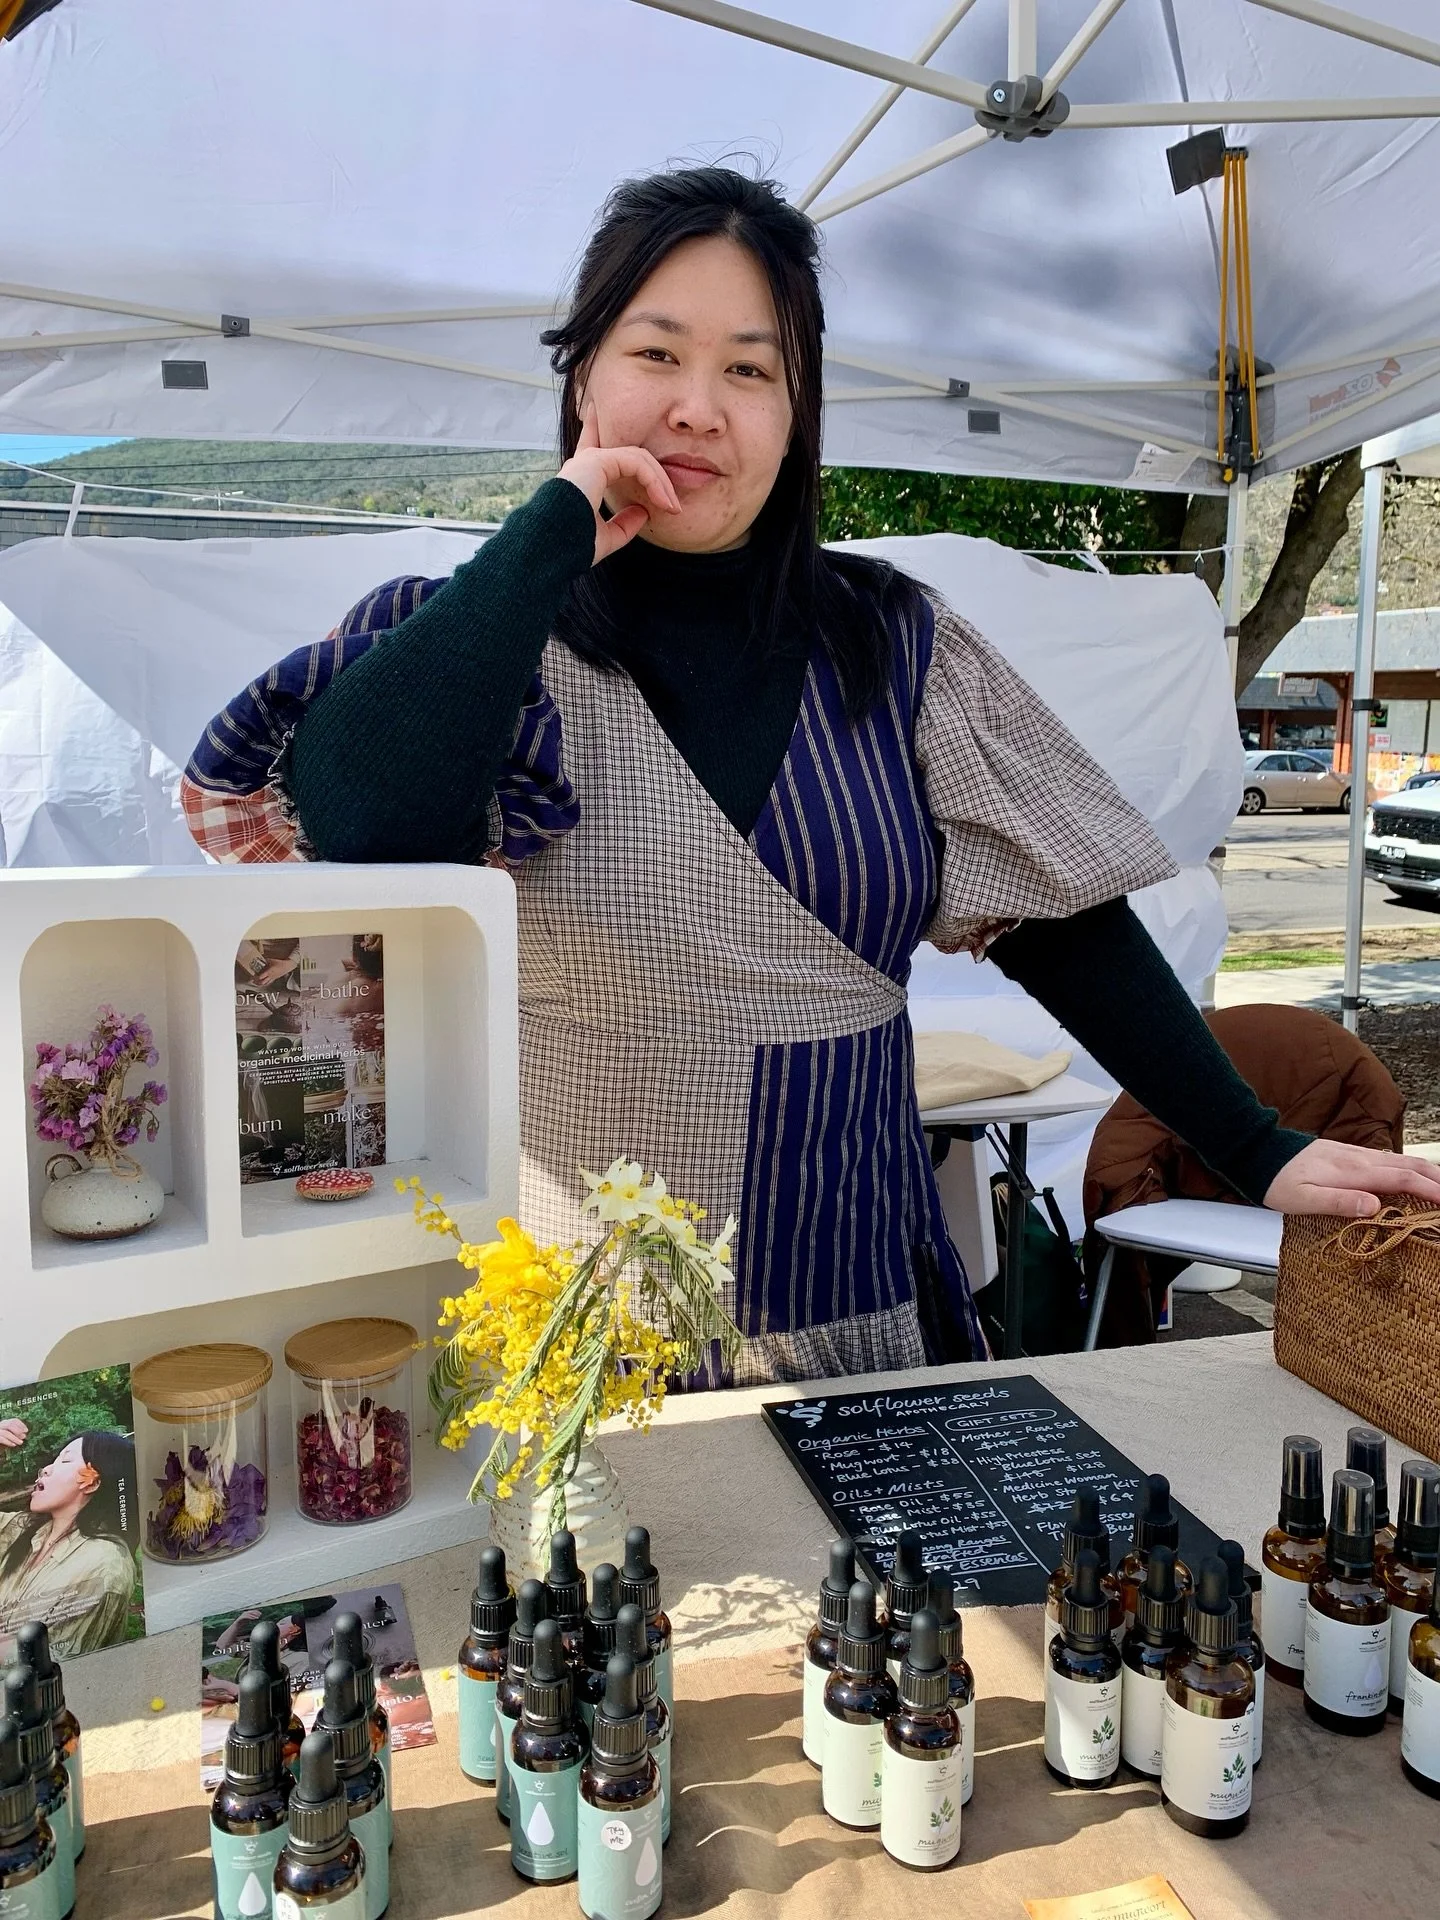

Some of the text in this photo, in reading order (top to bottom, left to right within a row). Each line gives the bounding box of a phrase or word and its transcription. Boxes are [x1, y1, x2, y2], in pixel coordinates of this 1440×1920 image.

[320, 981, 370, 999] bathe
[239, 1048, 366, 1069] organic medicinal herbs
[323, 1105, 372, 1125] make
[239, 1118, 283, 1135] burn
[283, 1160, 339, 1173] solflower seeds
[16, 1391, 58, 1407] ESSENCES
[837, 1386, 1011, 1417] solflower seeds
[956, 1411, 1038, 1428] GIFT SETS
[797, 1426, 926, 1451] Organic Herbs
[961, 1429, 1012, 1443] Mother
[1053, 1419, 1079, 1429] Set
[1035, 1432, 1066, 1443] $90
[822, 1441, 914, 1460] Rose $14
[919, 1446, 950, 1459] $18
[1075, 1450, 1102, 1460] Set
[836, 1457, 961, 1483] Blue Lotus $38
[1065, 1461, 1107, 1473] $128
[832, 1488, 873, 1502] Oils
[887, 1480, 945, 1495] Mists
[1002, 1473, 1119, 1494] Medicine Woman
[1011, 1491, 1049, 1504] Herb
[1112, 1479, 1140, 1490] Kit
[859, 1491, 975, 1514] Rose Oil $55
[118, 1495, 128, 1532] CEREMONY
[865, 1512, 902, 1524] Rose
[906, 1504, 942, 1517] Mist
[869, 1525, 902, 1536] Blue
[902, 1519, 938, 1531] Lotus
[940, 1515, 962, 1525] Oil
[875, 1536, 898, 1547] Blu
[919, 1529, 950, 1541] otus
[950, 1524, 979, 1535] Mist
[957, 1534, 1008, 1548] Ranges
[924, 1546, 990, 1562] Crafted
[959, 1552, 1029, 1571] Essences
[211, 1646, 233, 1657] on
[295, 1670, 321, 1678] WORK
[606, 1825, 625, 1836] TRY
[609, 1836, 624, 1845] ME
